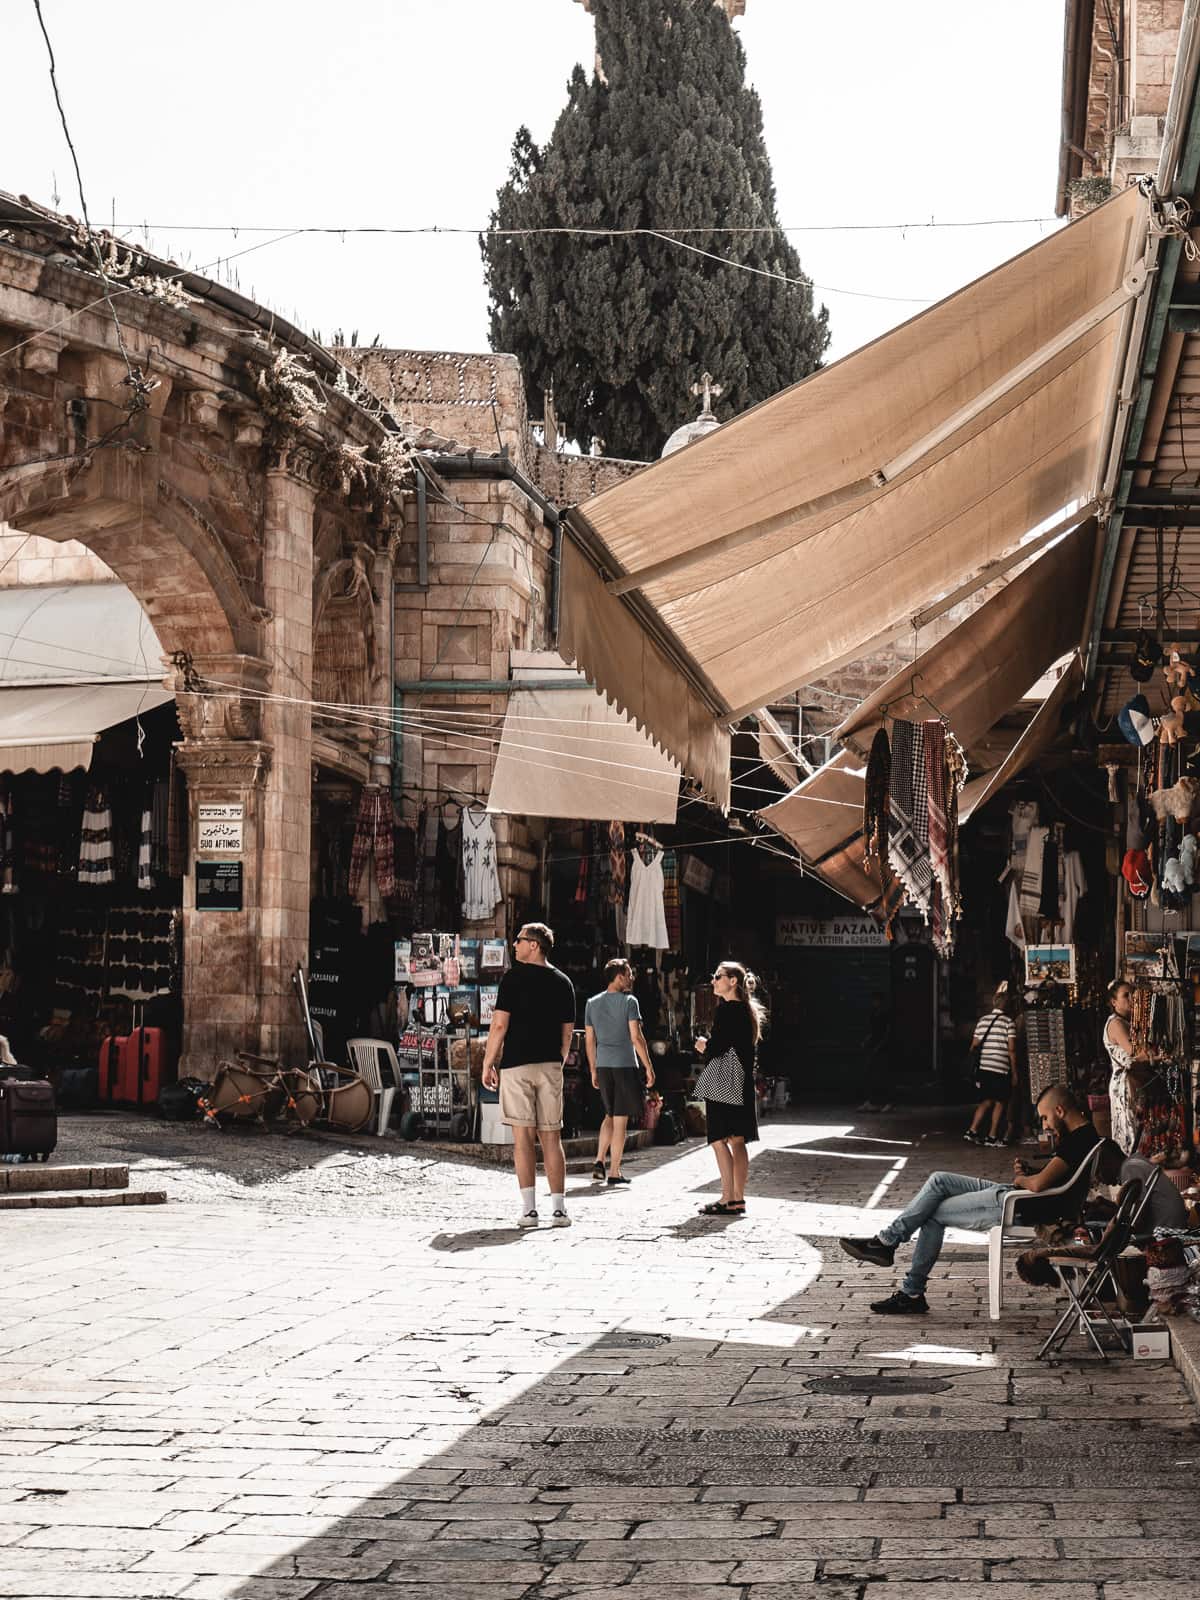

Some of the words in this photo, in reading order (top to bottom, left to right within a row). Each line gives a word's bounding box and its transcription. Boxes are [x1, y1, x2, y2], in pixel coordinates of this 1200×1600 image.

[215, 839, 240, 848] AFTIMOS
[780, 921, 826, 934] NATIVE
[834, 922, 885, 934] BAZAAR
